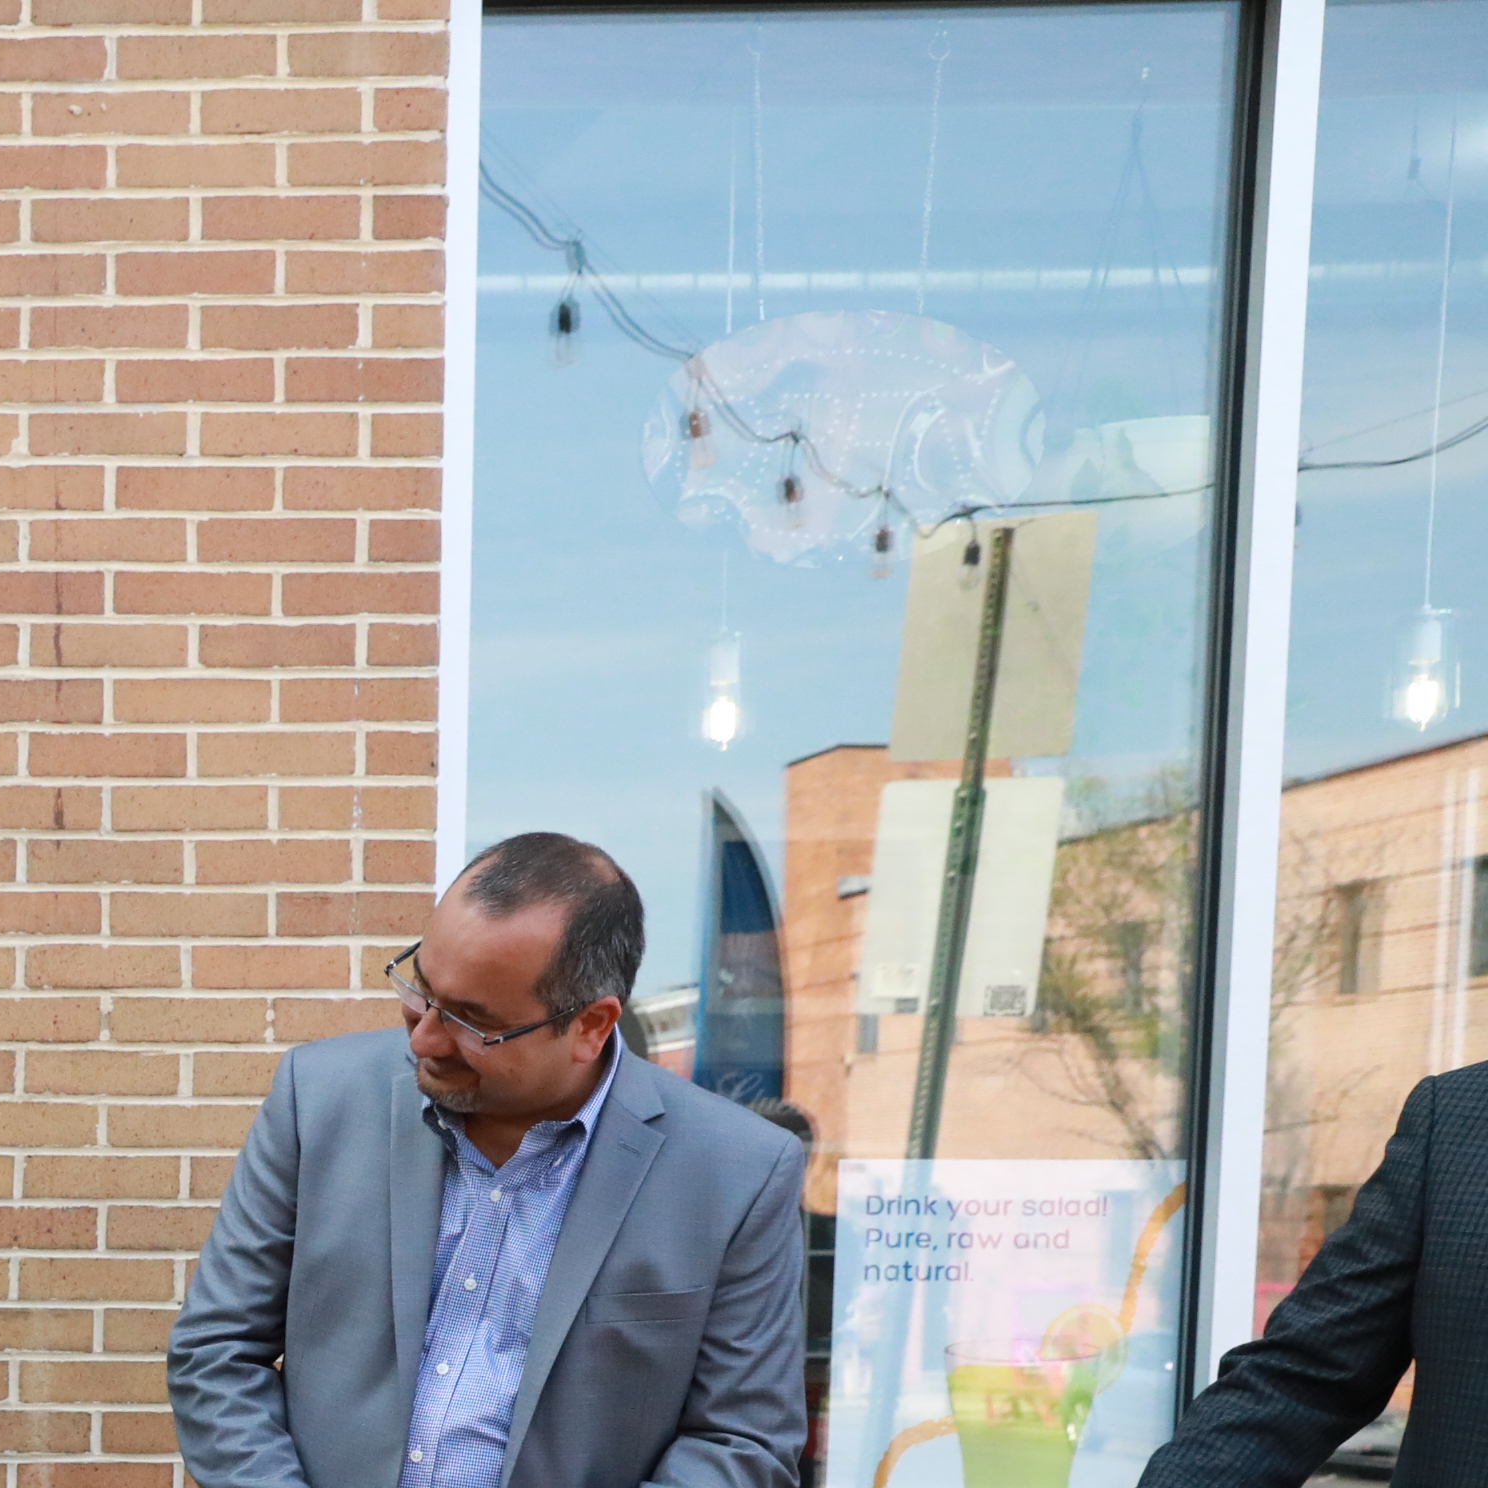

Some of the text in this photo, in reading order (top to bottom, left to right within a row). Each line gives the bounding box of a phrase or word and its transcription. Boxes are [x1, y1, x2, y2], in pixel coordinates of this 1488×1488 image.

[865, 1194, 1108, 1222] Drink your salad!
[865, 1228, 1070, 1251] Pure, raw and
[864, 1261, 975, 1282] natural.
